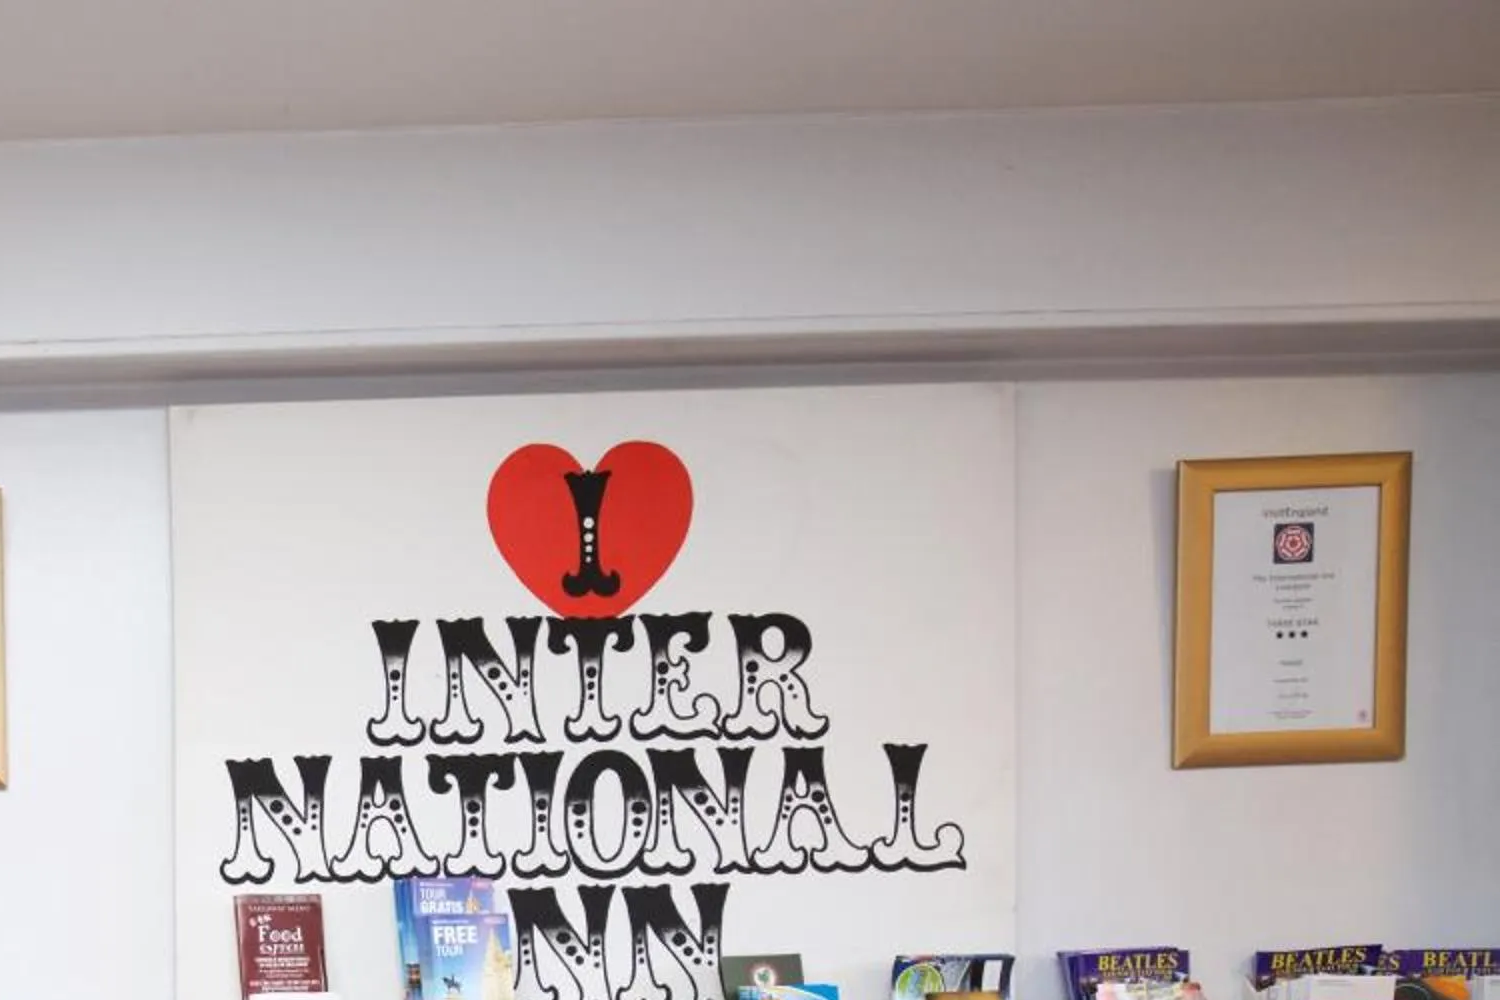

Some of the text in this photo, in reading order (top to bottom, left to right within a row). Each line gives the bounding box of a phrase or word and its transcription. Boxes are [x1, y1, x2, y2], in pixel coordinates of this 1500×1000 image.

[561, 469, 621, 597] I
[366, 611, 830, 746] INTER
[219, 743, 967, 885] NATIONAL
[258, 925, 303, 942] Food
[433, 925, 478, 944] FREE
[1098, 951, 1180, 971] BEATLES
[1271, 947, 1367, 971] BEATLES
